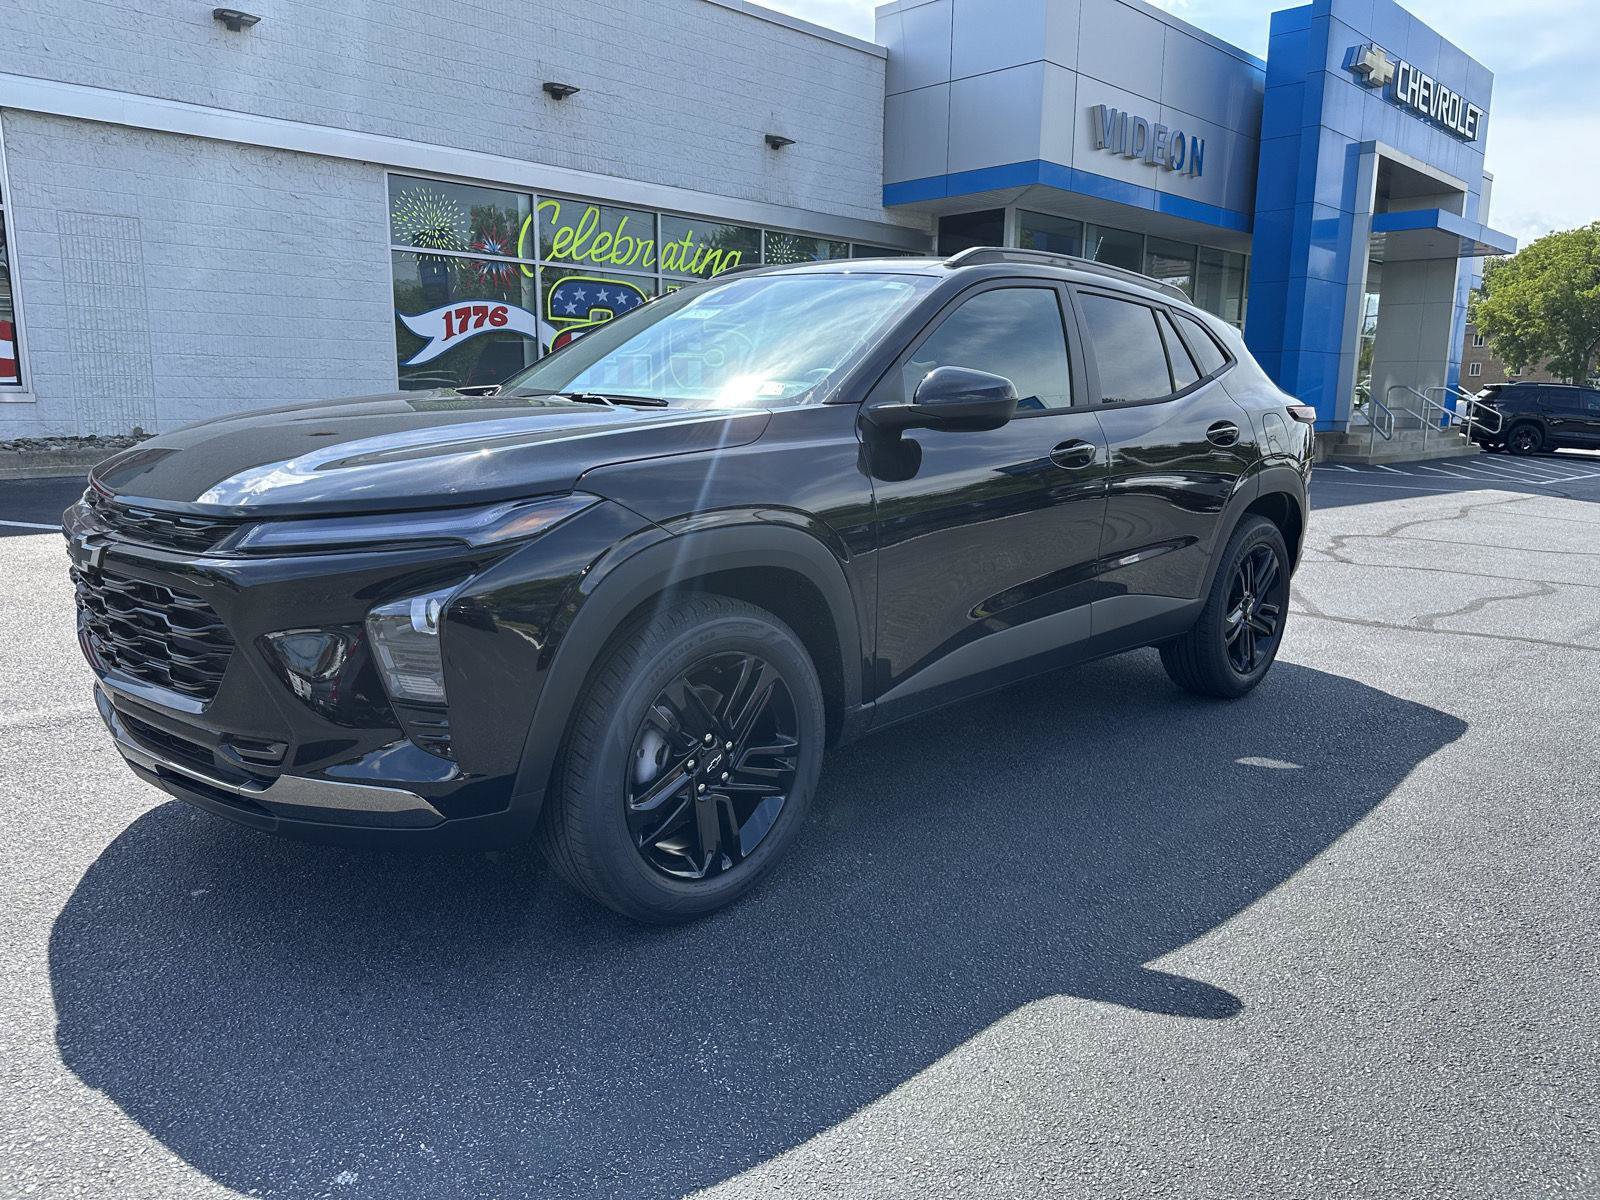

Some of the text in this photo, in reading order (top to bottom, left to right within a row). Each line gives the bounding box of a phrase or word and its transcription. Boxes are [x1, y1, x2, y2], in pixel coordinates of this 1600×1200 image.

[1395, 61, 1482, 141] CHEVROLET
[1092, 104, 1206, 178] VIDEON
[517, 200, 742, 276] Celebrating
[441, 305, 508, 342] 1776
